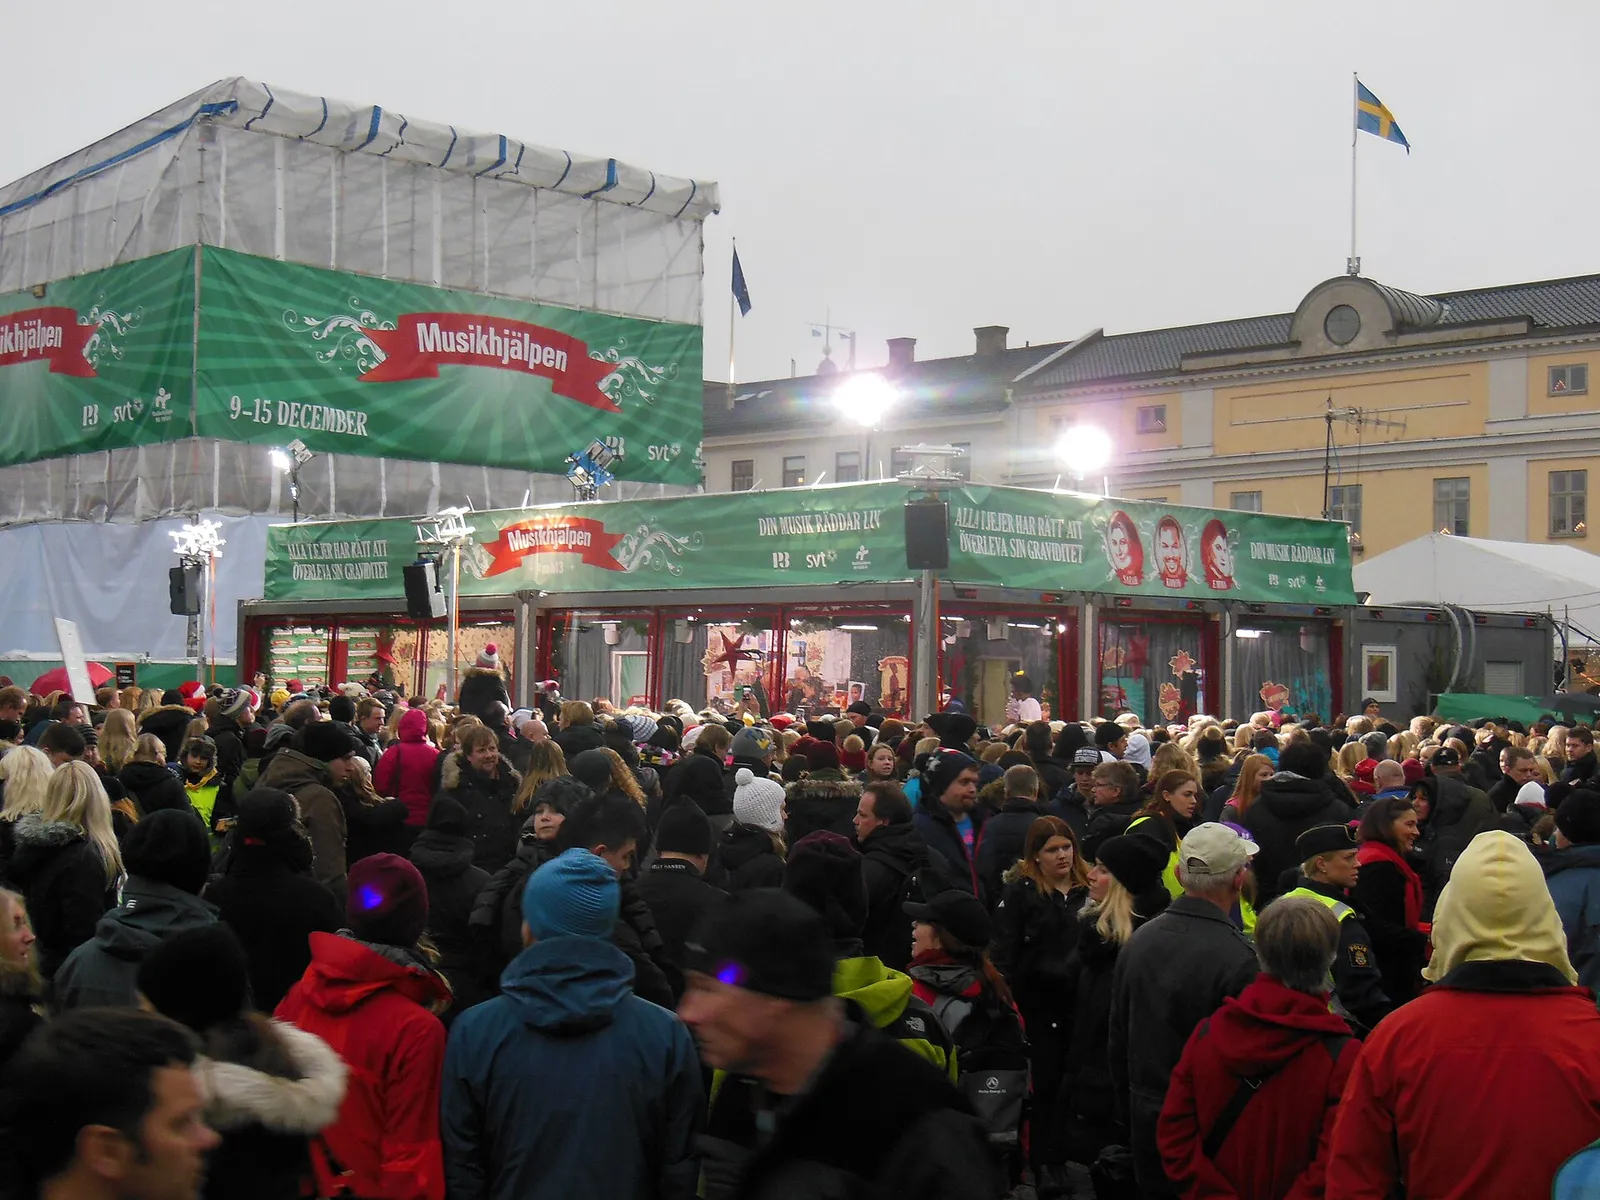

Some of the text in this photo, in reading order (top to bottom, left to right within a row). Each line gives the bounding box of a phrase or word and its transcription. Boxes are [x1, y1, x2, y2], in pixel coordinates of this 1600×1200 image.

[416, 322, 568, 372] Musikhjälpen
[277, 400, 368, 437] DECEMBER
[758, 510, 881, 536] DIN MUSIK RÄDDAR LIV
[1015, 514, 1036, 536] HAR
[1037, 515, 1065, 538] RÄTT
[333, 542, 351, 559] HAR
[507, 523, 592, 552] Musikhjälpen
[959, 529, 1009, 557] ÖVERLEVA
[1009, 538, 1027, 559] SIN
[806, 551, 827, 568] svt
[1291, 543, 1323, 564] RÄDDAR
